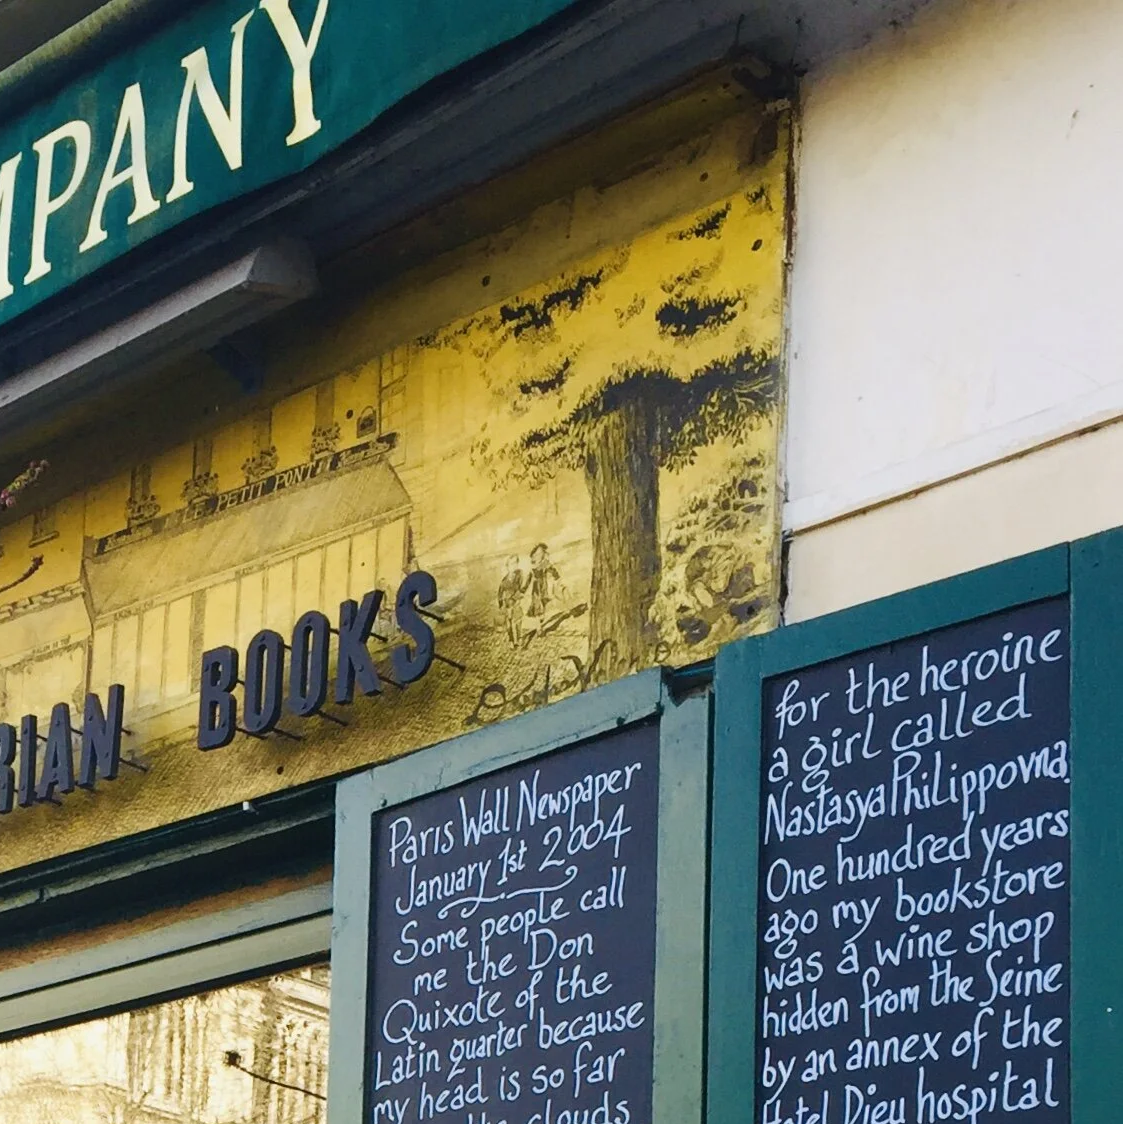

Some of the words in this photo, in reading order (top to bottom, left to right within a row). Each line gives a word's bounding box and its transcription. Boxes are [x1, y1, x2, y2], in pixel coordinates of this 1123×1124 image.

[197, 571, 438, 752] BOOKS
[776, 680, 830, 740] for
[846, 663, 909, 714] the
[921, 629, 1063, 696] heroine
[768, 747, 788, 783] a
[802, 712, 882, 793] girl
[892, 673, 1031, 752] called
[389, 817, 453, 867] Paris
[459, 786, 510, 847] Wall
[516, 762, 641, 832] Newspaper
[395, 860, 491, 917] January
[497, 839, 527, 885] 1st
[539, 805, 631, 871] 2004
[767, 858, 826, 902] One
[836, 811, 975, 885] hundred
[981, 810, 1069, 876] years
[393, 920, 468, 964] Some
[481, 891, 569, 959] people
[580, 866, 626, 908] call
[764, 908, 818, 959] ago
[832, 896, 881, 944] my
[895, 861, 1065, 922] bookstore
[375, 1043, 440, 1091] Latin
[447, 1021, 527, 1081] quarter
[539, 1002, 645, 1048] because
